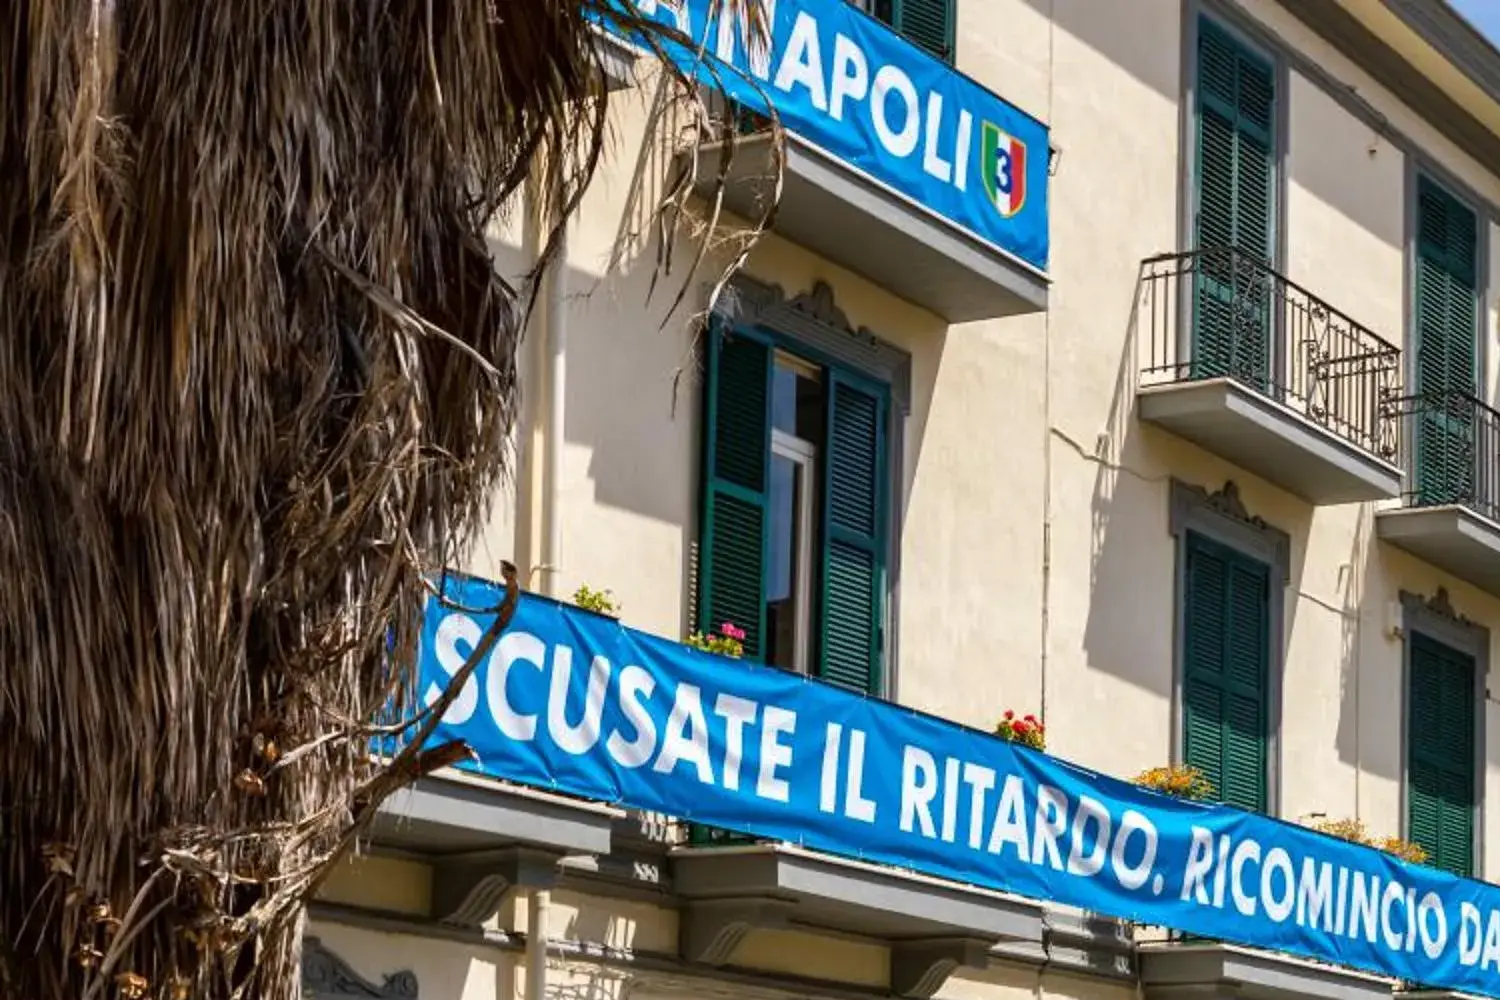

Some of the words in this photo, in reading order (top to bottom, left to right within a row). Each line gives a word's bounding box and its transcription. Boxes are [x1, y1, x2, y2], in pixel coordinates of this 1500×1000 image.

[994, 147, 1013, 194] 3
[424, 613, 797, 802] SCUSATE
[820, 721, 876, 823] IL
[900, 745, 1163, 896] RITARDO.
[1180, 826, 1446, 960] RICOMINCIO
